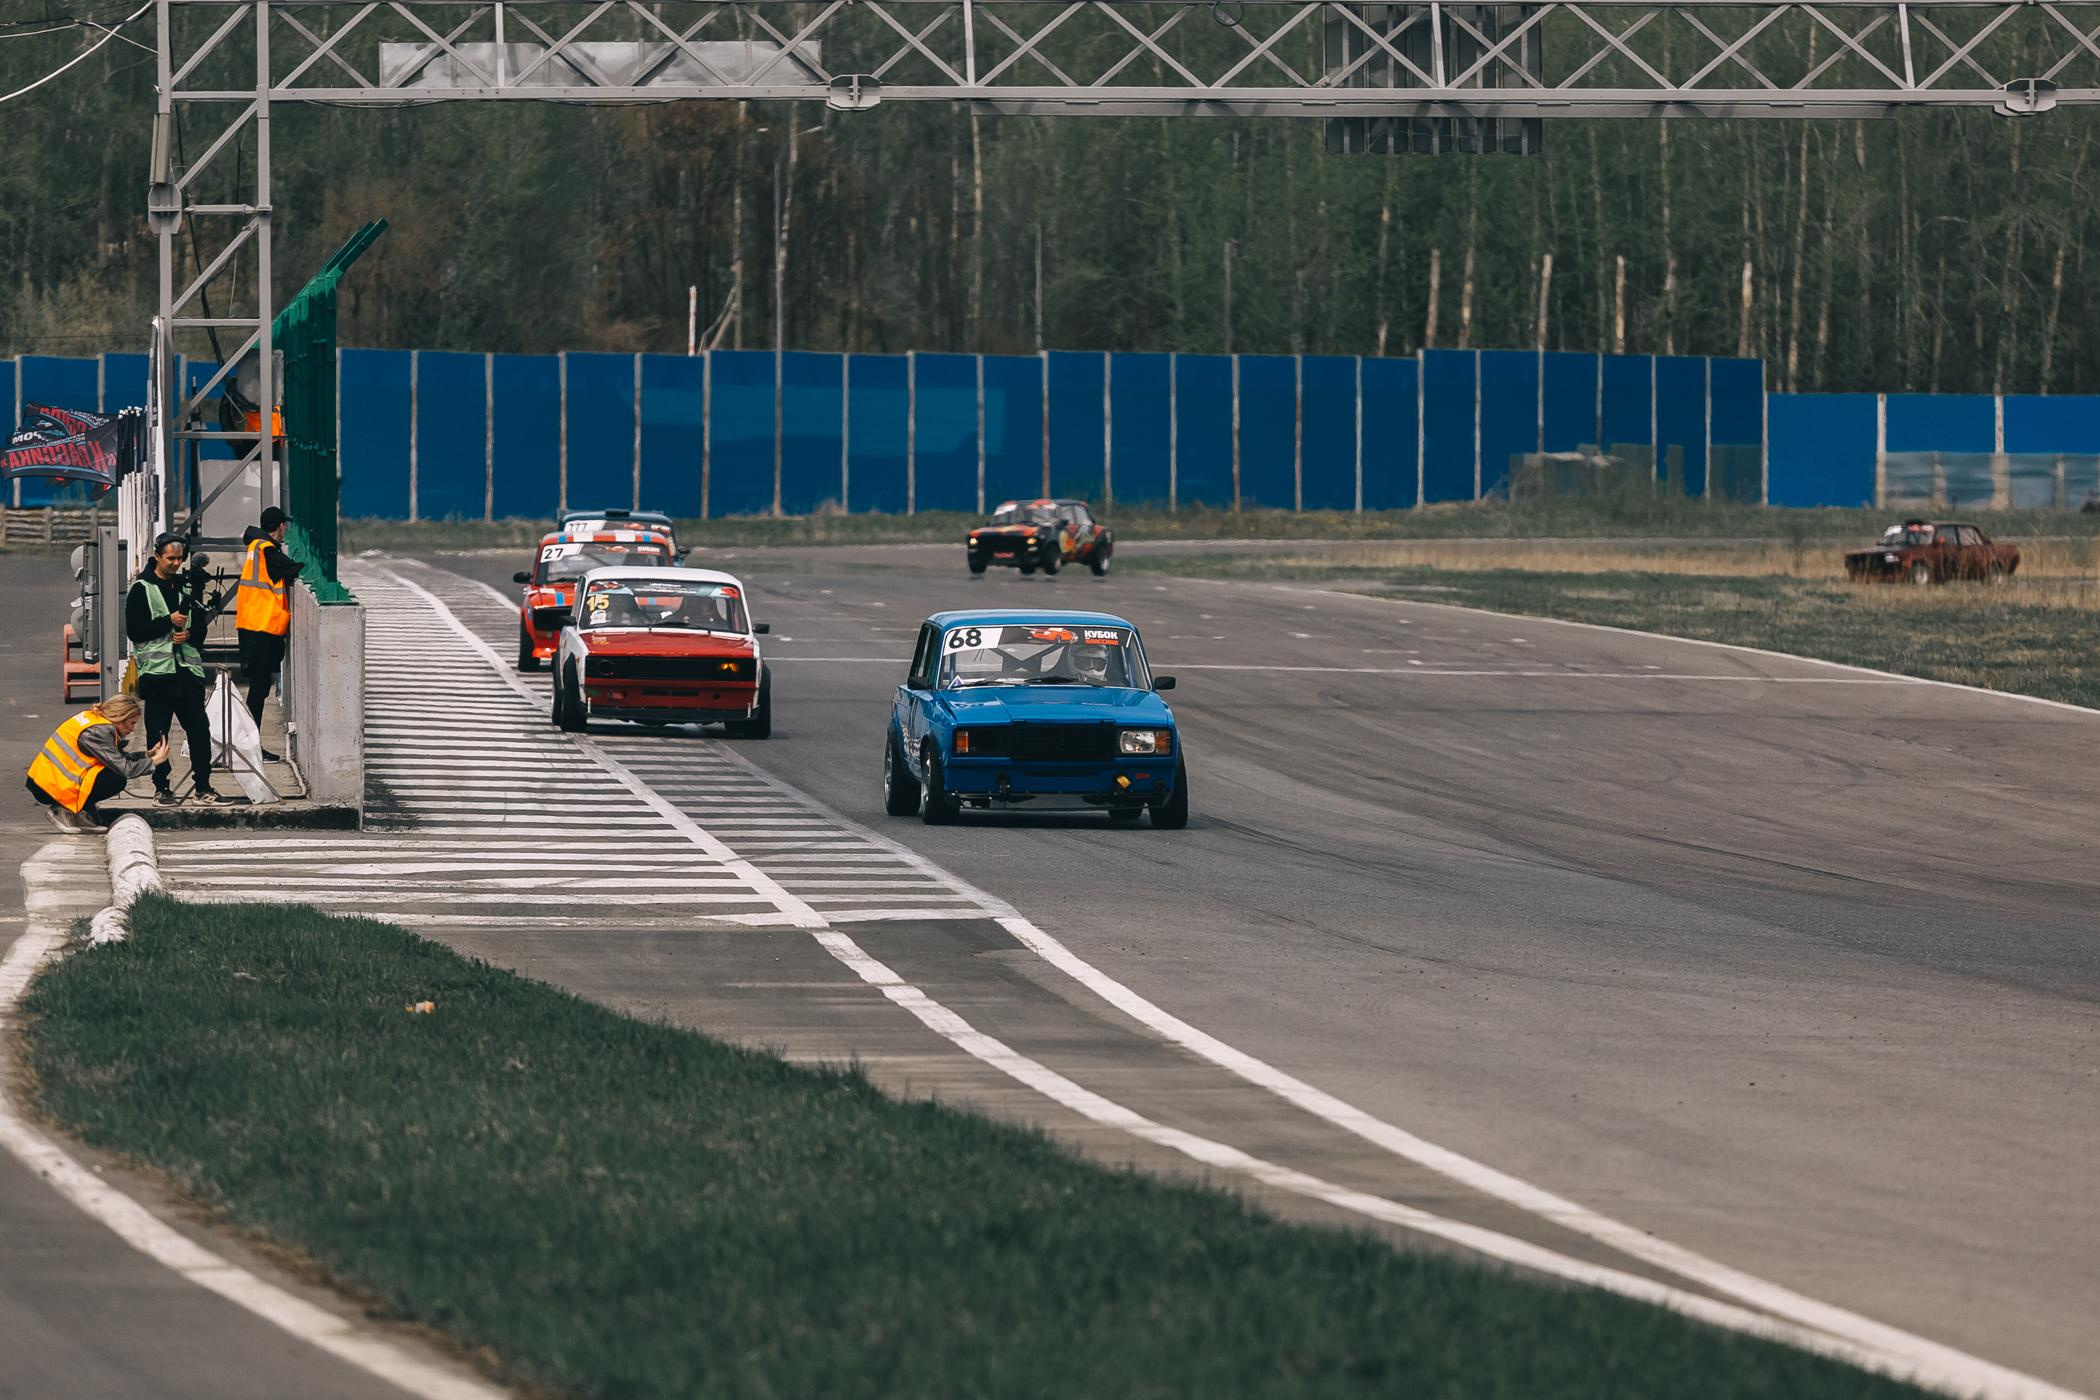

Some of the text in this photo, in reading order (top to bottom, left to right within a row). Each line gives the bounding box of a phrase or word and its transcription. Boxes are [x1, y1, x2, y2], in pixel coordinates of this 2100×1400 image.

[544, 548, 563, 559] 27
[587, 594, 609, 611] 15
[949, 629, 982, 649] 68
[1084, 630, 1118, 639] КУБОК
